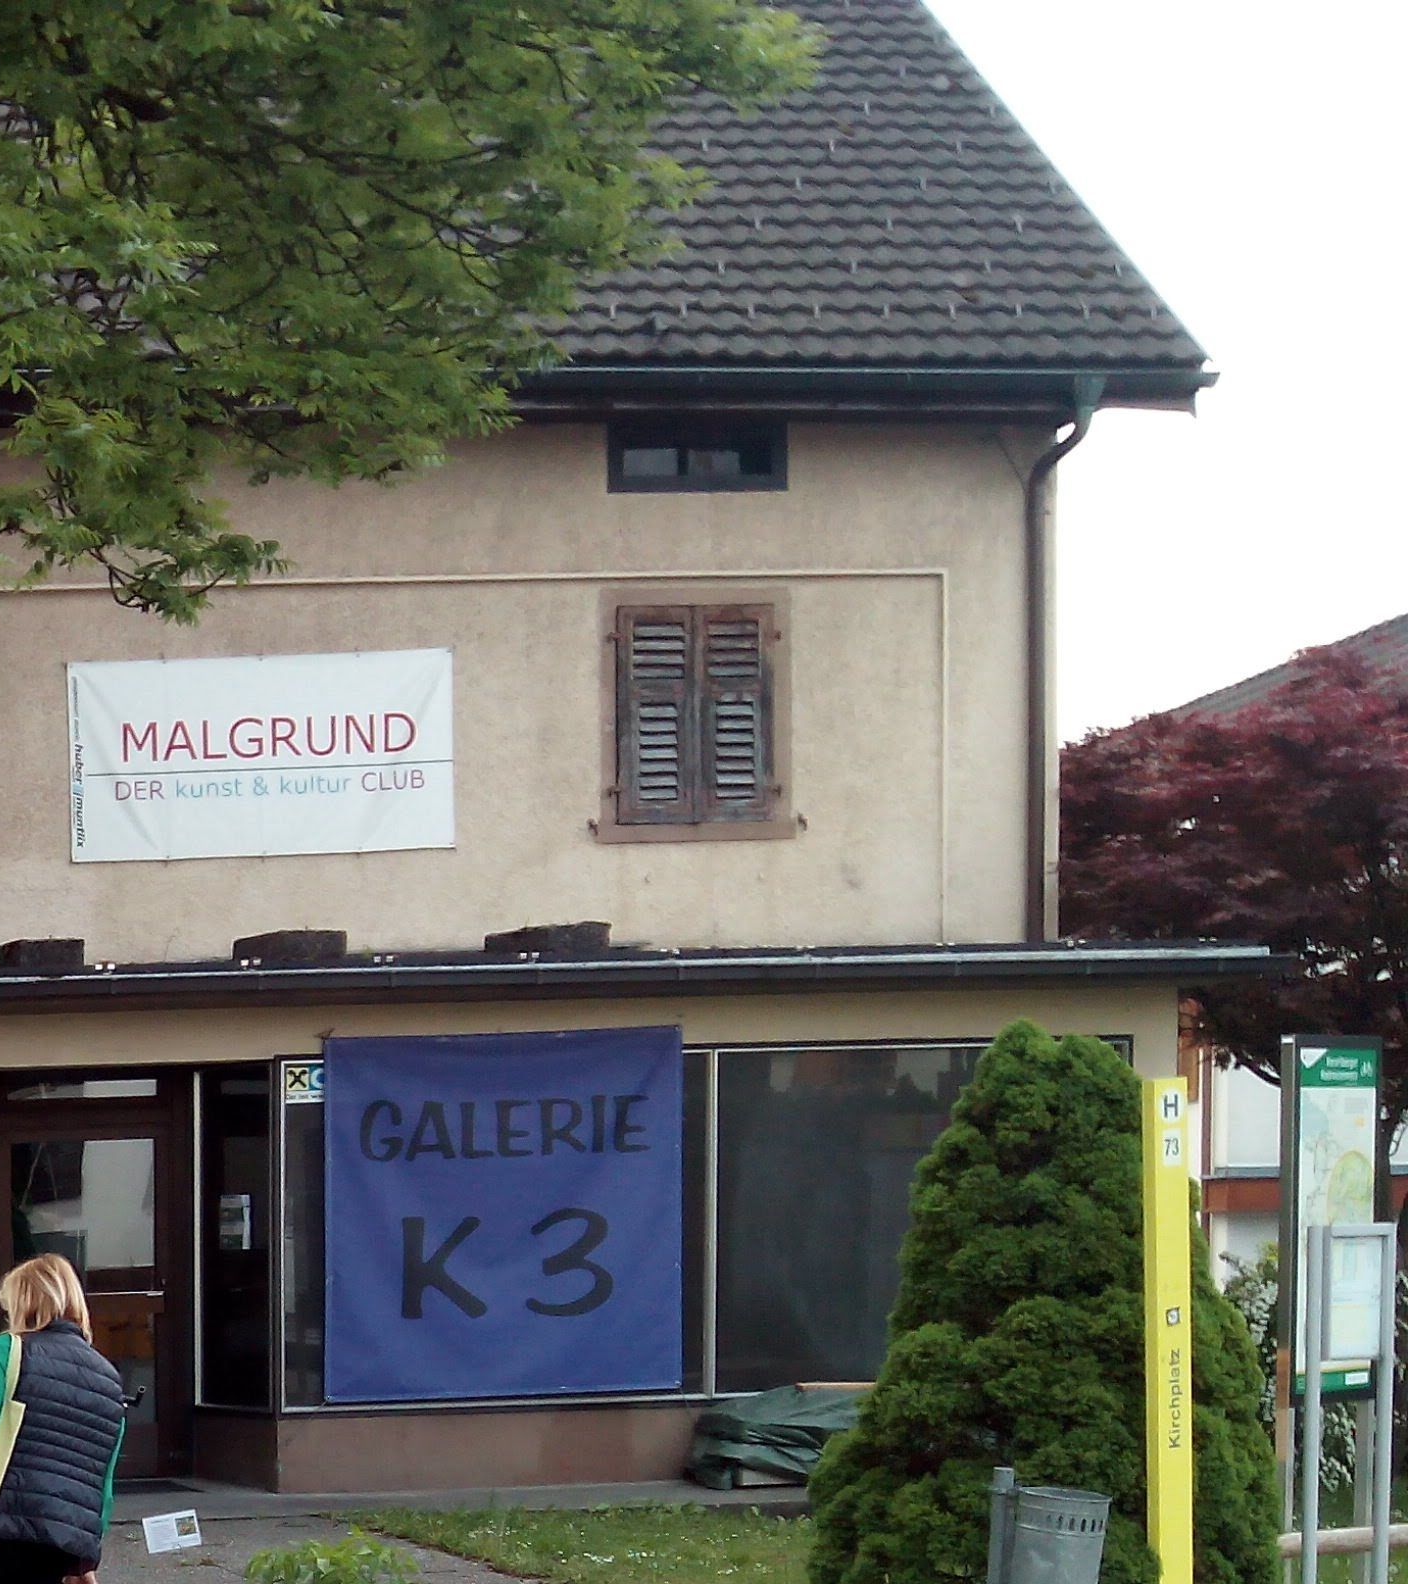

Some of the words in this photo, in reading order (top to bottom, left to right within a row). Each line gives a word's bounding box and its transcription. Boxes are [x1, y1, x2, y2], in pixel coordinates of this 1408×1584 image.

[120, 711, 417, 763] MALGRUND
[73, 743, 84, 785] huber
[115, 780, 164, 801] DER
[175, 777, 242, 798] kunst
[253, 775, 270, 797] &
[280, 773, 351, 794] kultur
[361, 769, 425, 792] CLUB
[1163, 1095, 1180, 1118] H
[359, 1094, 651, 1162] GALERIE
[1163, 1139, 1180, 1157] 73
[1169, 1348, 1183, 1448] Kirchplatz
